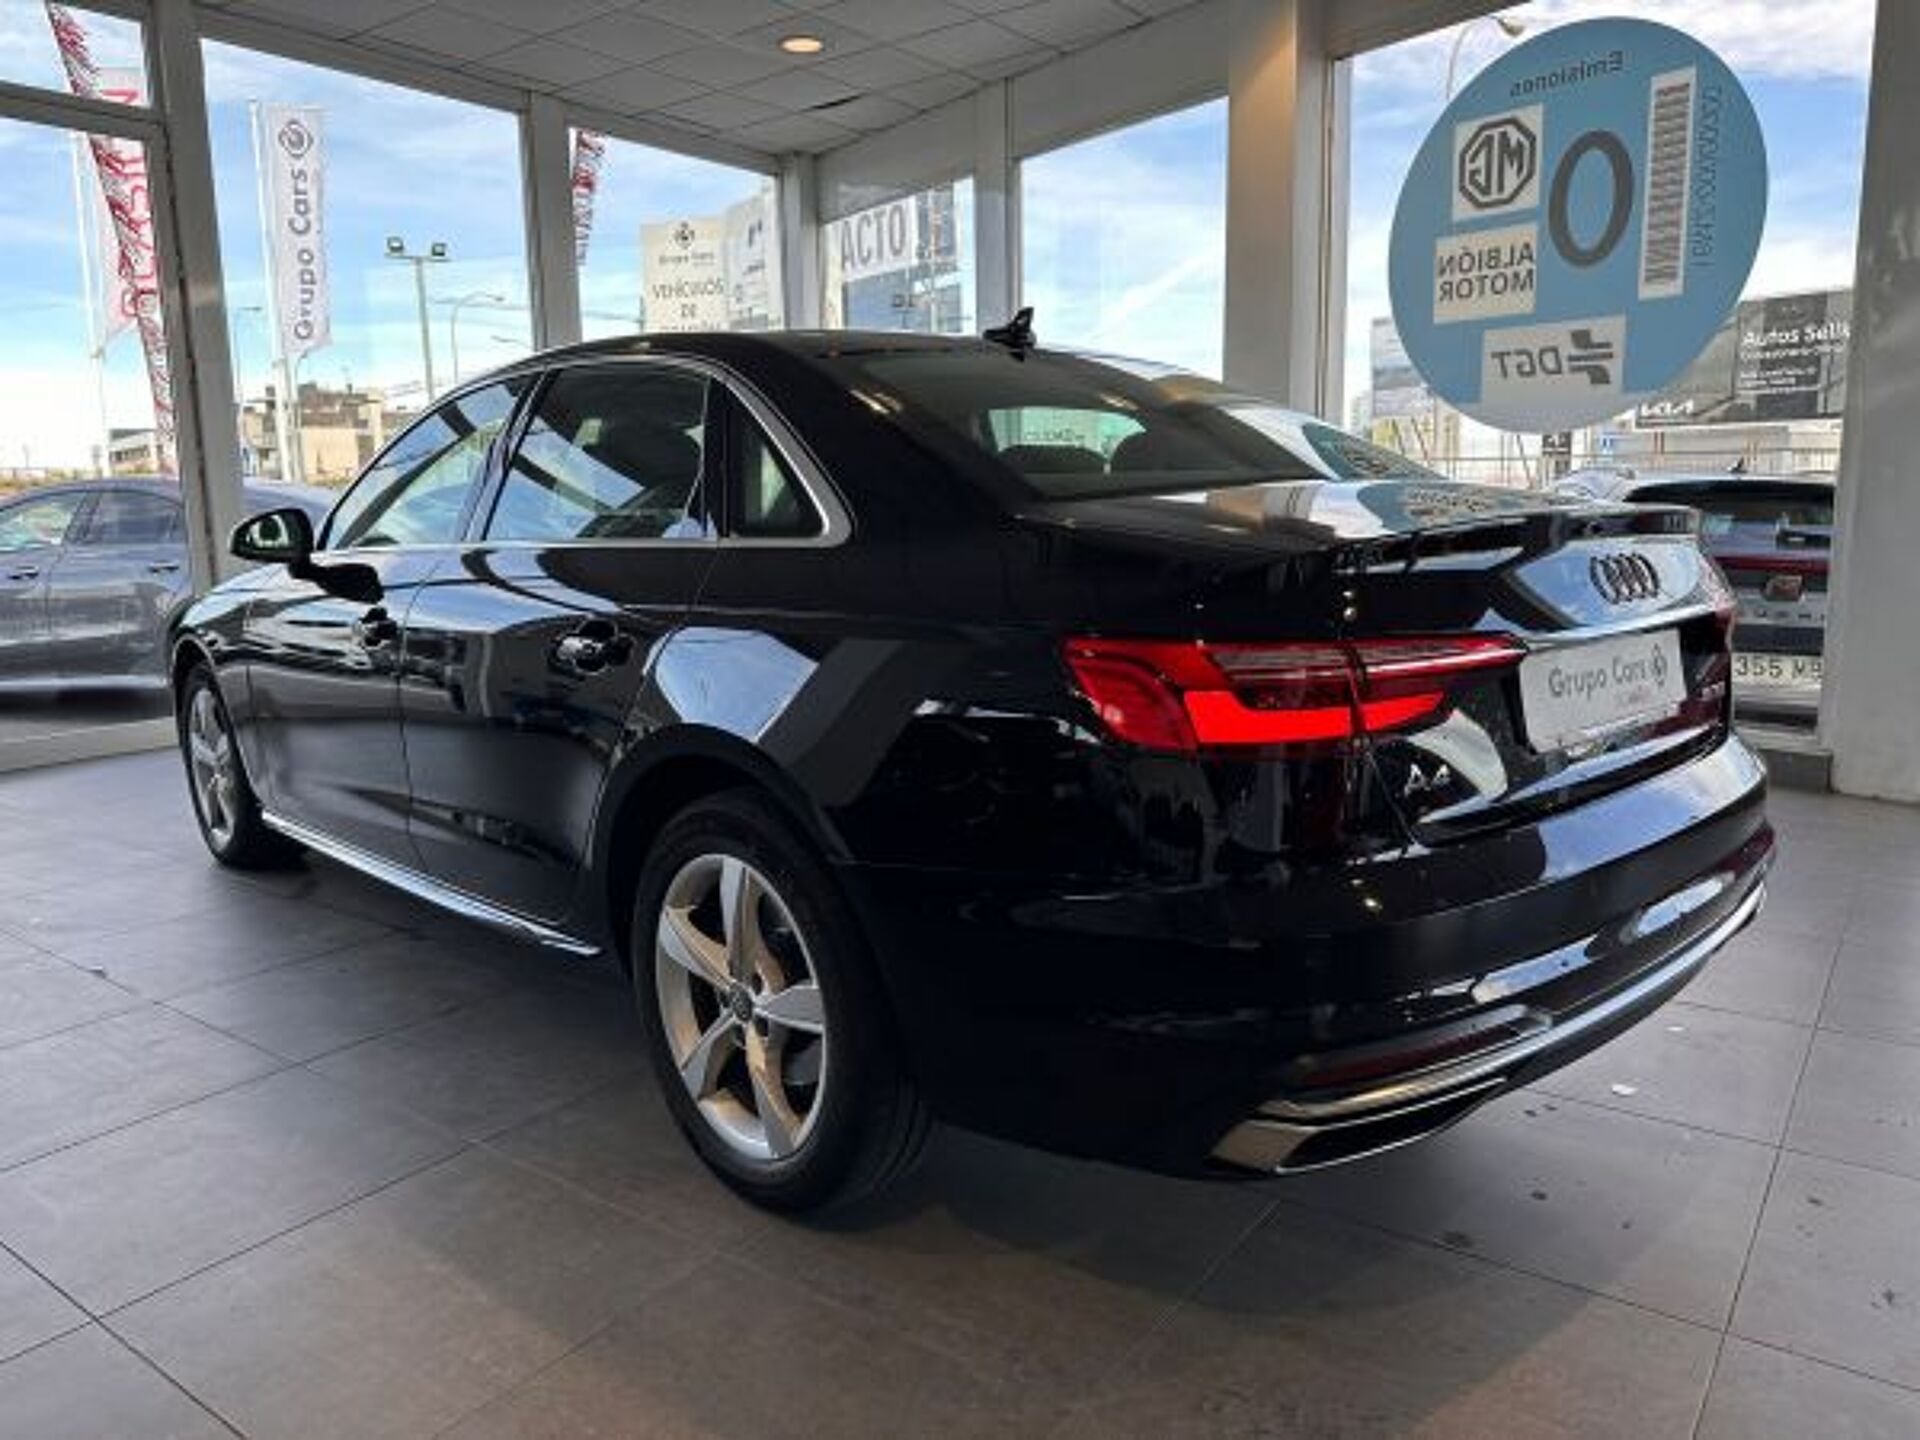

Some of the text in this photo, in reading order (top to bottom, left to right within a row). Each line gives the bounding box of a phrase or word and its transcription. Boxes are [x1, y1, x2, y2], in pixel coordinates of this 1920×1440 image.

[288, 169, 317, 340] Grupo Cars
[1548, 666, 1607, 699] Grupo
[1612, 655, 1646, 684] Cars
